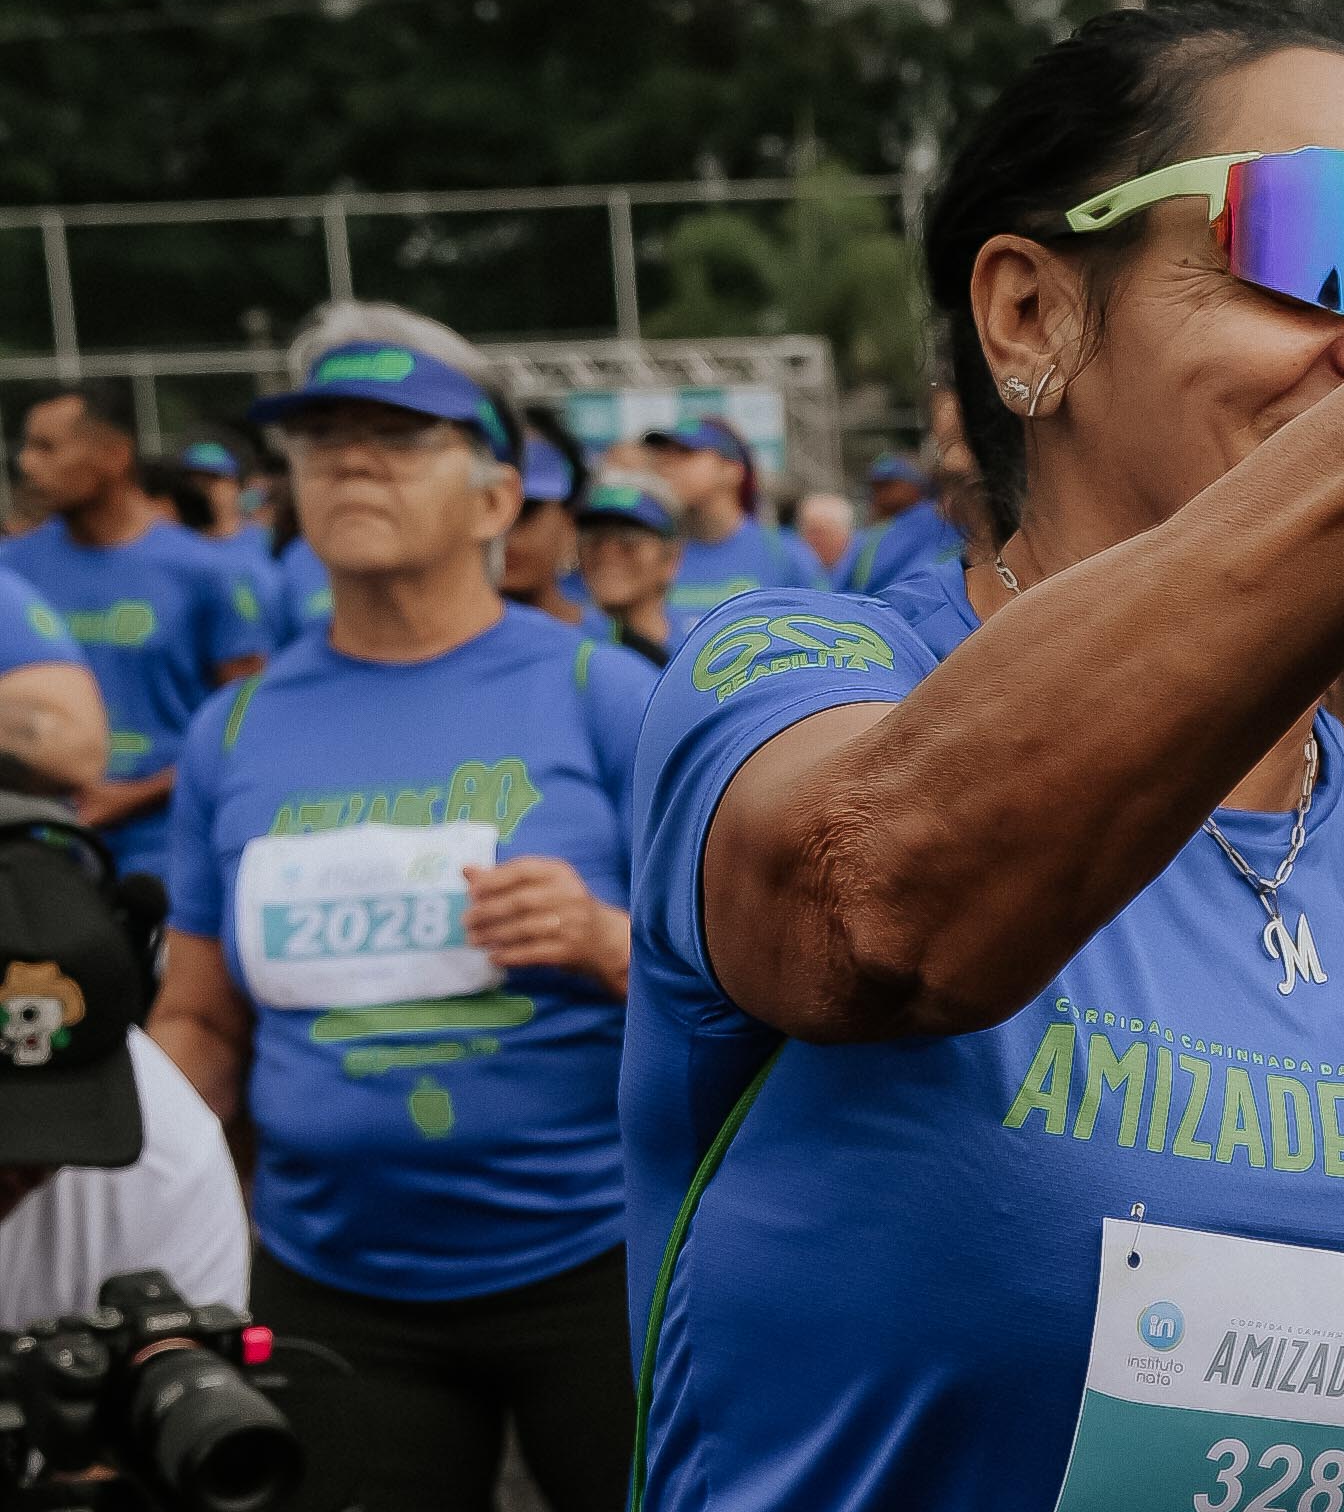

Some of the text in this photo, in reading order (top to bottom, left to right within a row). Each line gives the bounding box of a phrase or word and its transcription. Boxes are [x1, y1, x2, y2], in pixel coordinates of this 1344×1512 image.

[288, 896, 450, 954] 2028
[1054, 996, 1161, 1036] CORRIDA
[1180, 1033, 1313, 1074] CAMINHADA
[1230, 1317, 1284, 1332] CORRIDA
[1126, 1354, 1185, 1375] instituto
[1135, 1369, 1173, 1387] nata
